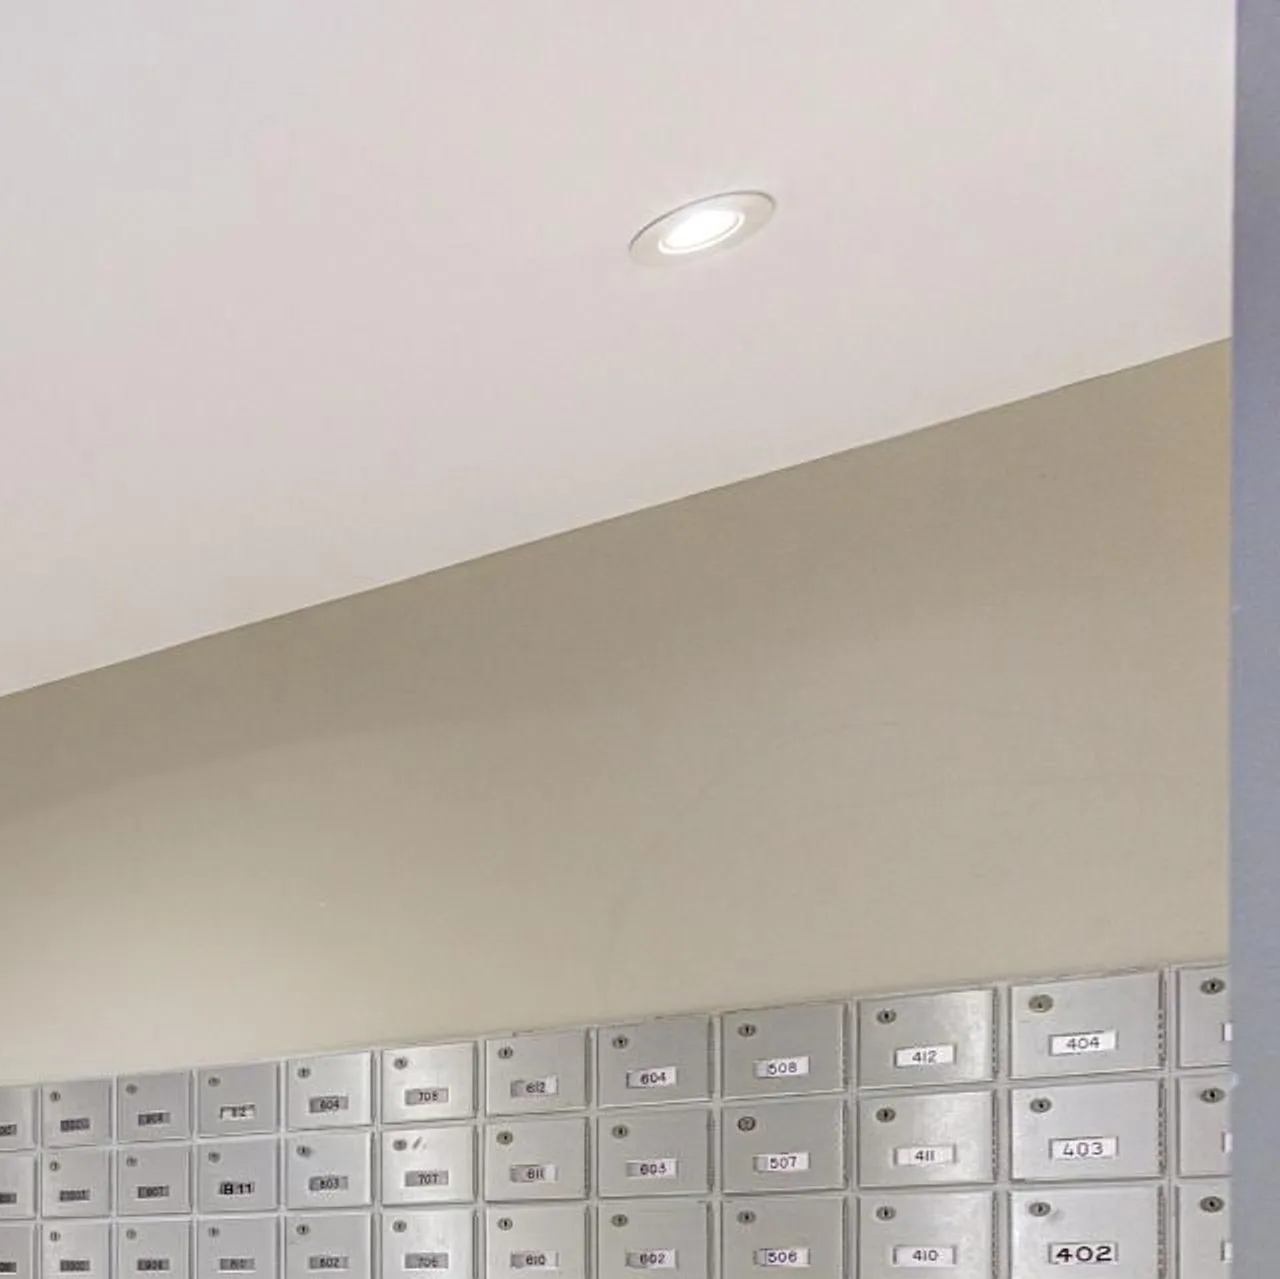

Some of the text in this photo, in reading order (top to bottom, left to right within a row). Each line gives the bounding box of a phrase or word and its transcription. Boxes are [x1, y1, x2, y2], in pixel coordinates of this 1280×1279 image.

[1065, 1036, 1100, 1051] 404
[912, 1050, 937, 1063] 412
[767, 1062, 797, 1075] 508
[914, 1150, 935, 1161] 411
[1063, 1141, 1104, 1158] 403
[769, 1156, 797, 1169] 507
[912, 1250, 939, 1261] 410
[1056, 1246, 1112, 1263] 402
